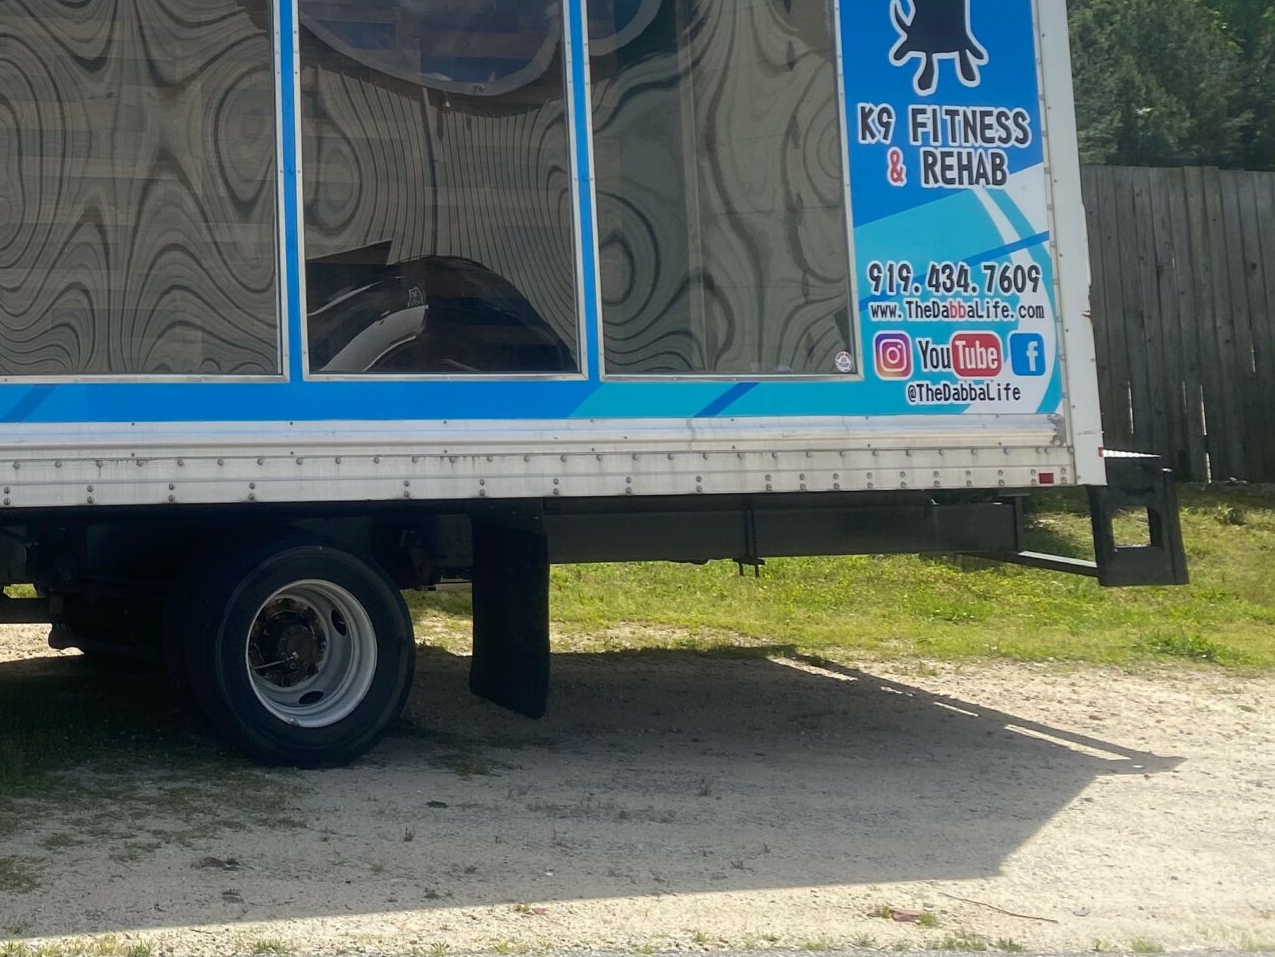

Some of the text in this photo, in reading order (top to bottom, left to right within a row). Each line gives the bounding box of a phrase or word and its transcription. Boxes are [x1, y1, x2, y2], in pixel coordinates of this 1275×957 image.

[859, 105, 1032, 146] K9 FITNESS
[888, 149, 1009, 186] & REHAB
[868, 262, 1041, 293] 919.434.7609
[870, 300, 1046, 320] www.TheDabbaLife.com
[917, 340, 1000, 371] YouTube
[907, 382, 1022, 403] @TheDabbaLife
